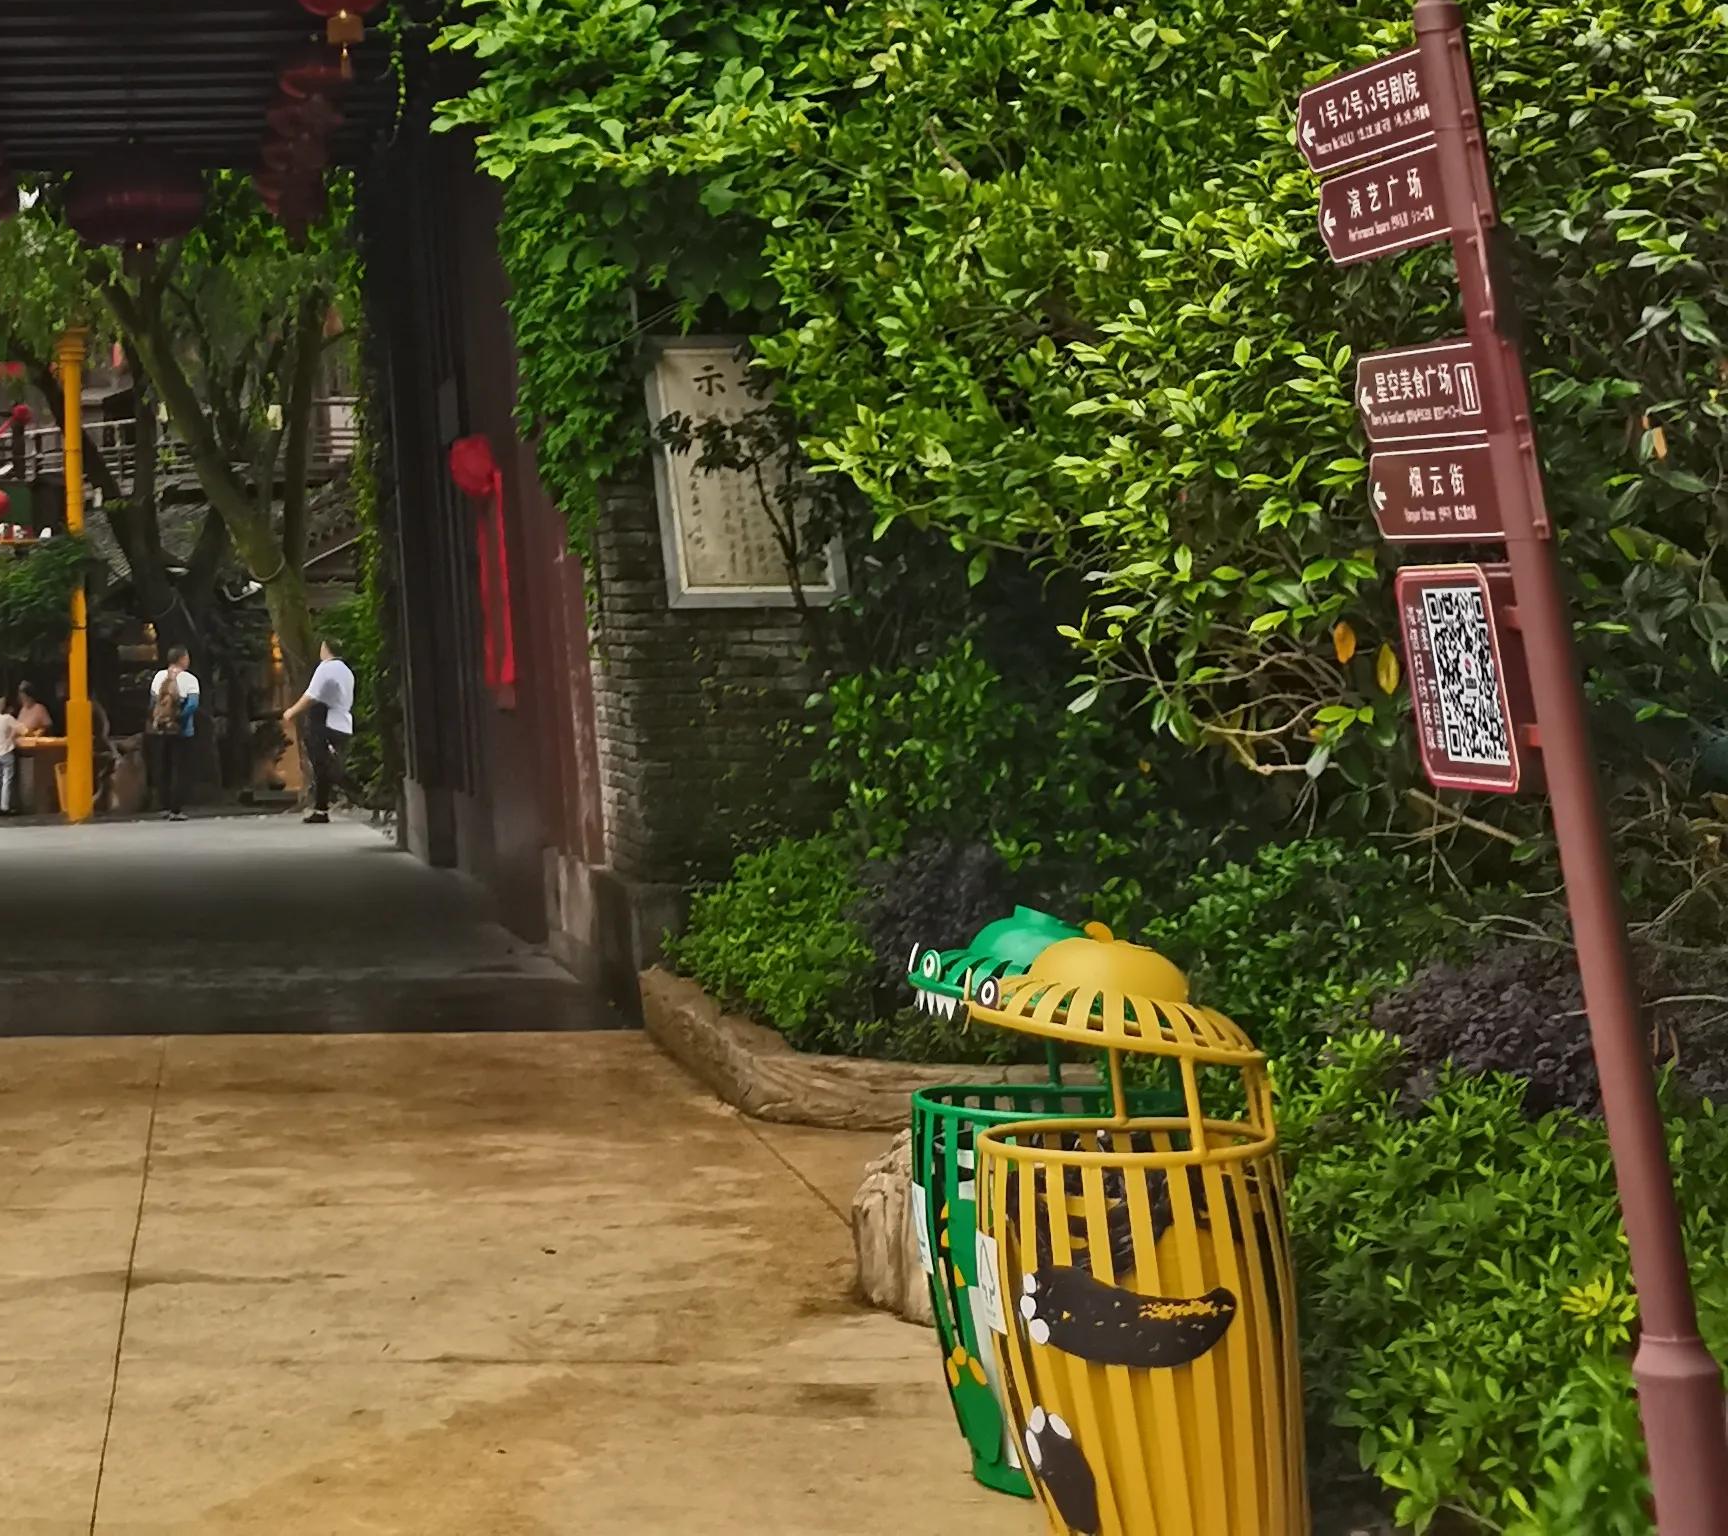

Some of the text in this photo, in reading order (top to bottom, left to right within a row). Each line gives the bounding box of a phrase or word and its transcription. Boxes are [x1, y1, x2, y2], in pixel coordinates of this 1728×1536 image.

[1347, 167, 1423, 219] 演艺广场
[1374, 363, 1453, 403] 星空美食广场
